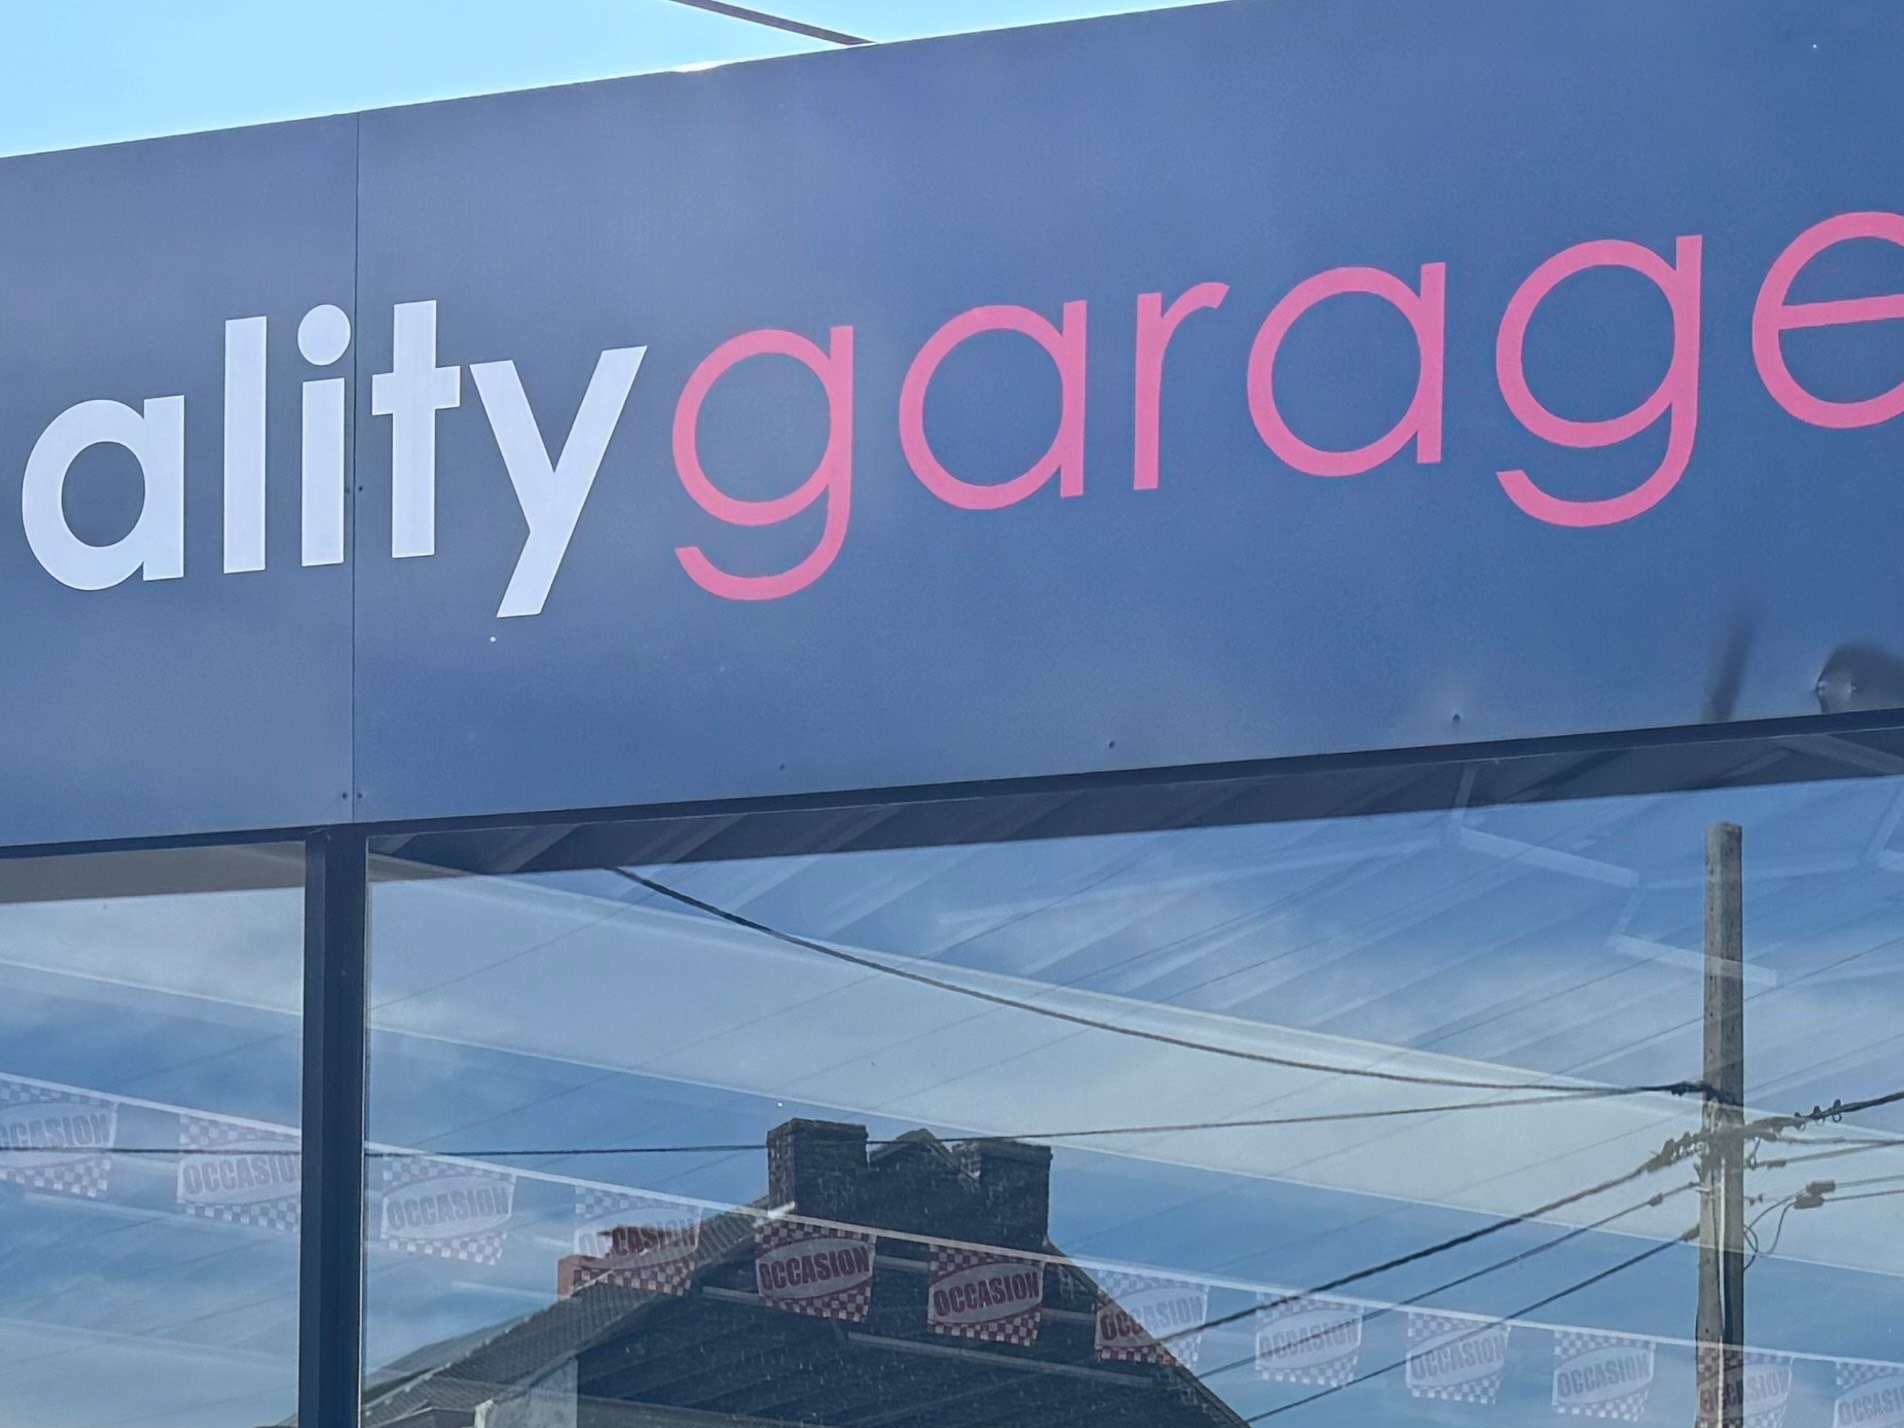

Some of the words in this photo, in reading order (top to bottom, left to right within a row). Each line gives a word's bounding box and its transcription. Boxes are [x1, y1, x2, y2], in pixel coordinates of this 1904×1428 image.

[182, 1154, 301, 1195] OCCASIO
[386, 1185, 511, 1229] OCCASION
[758, 1246, 870, 1291] OCCASION
[933, 1272, 1040, 1316] OCCASION
[1409, 1332, 1506, 1382] OCCASION
[1557, 1352, 1651, 1400] OCCASION
